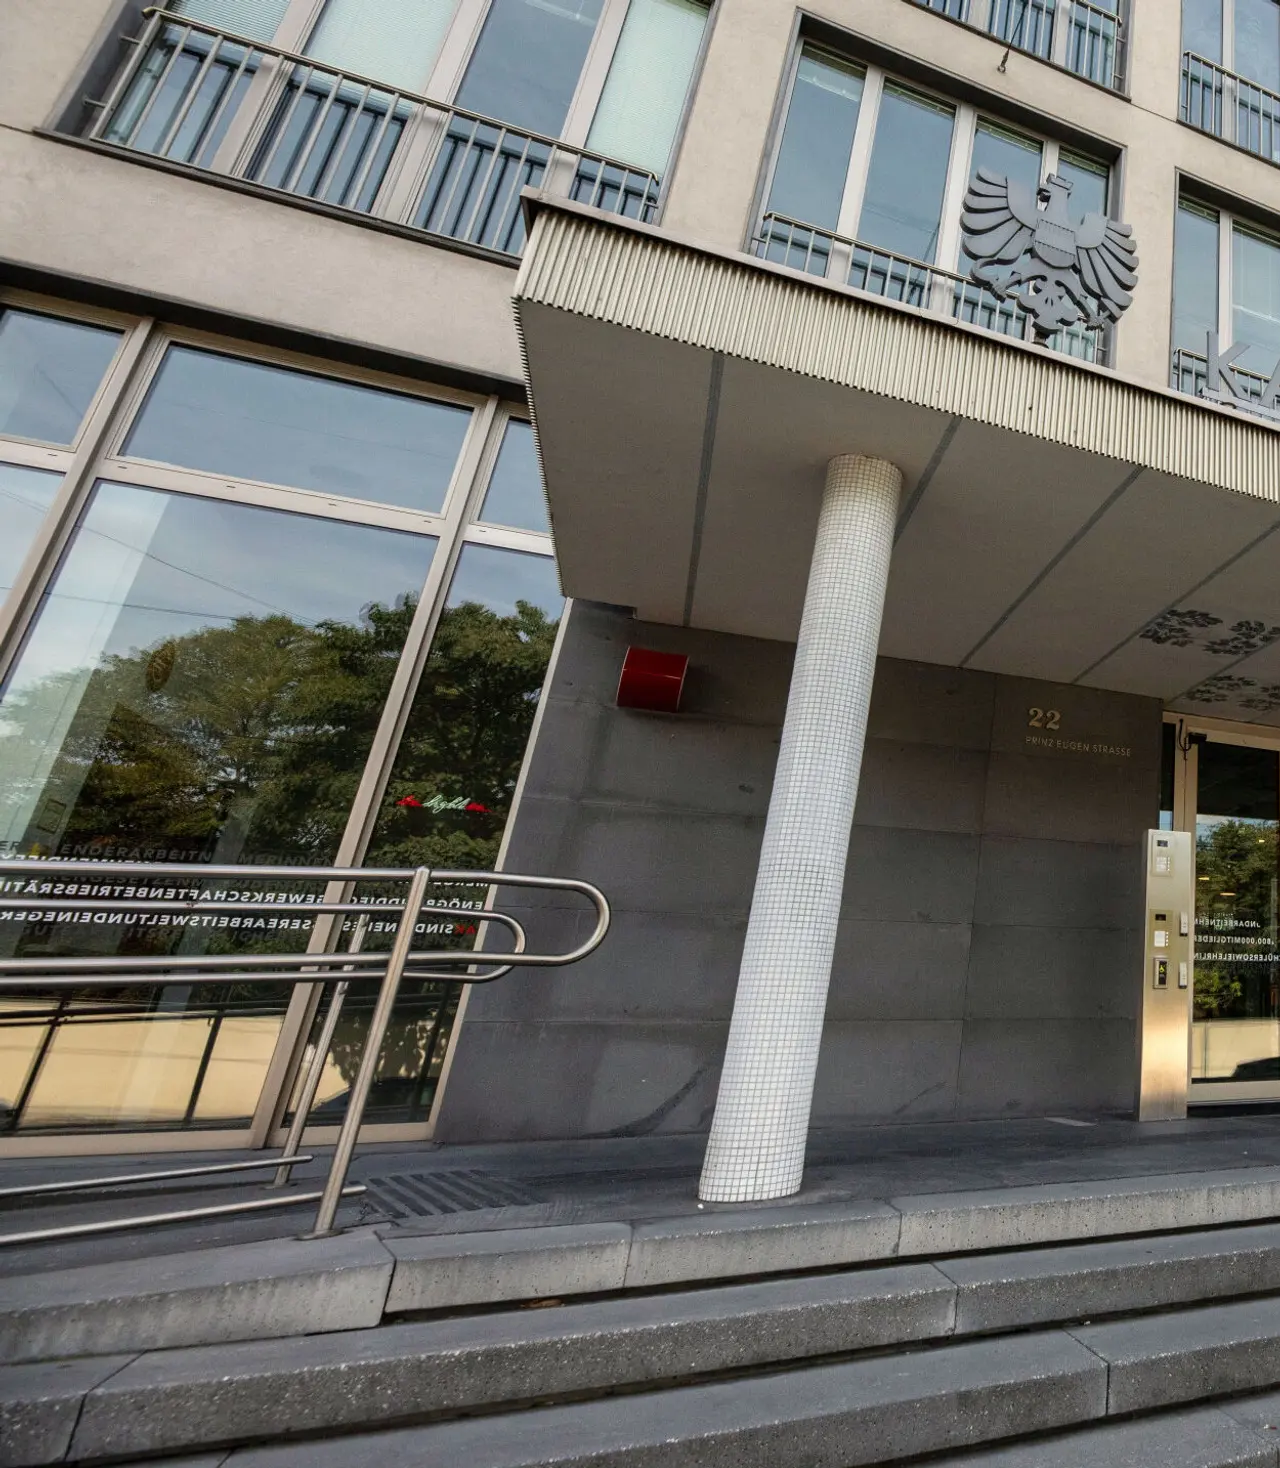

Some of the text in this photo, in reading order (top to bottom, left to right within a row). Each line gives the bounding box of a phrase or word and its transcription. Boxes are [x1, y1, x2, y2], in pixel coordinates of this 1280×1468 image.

[1029, 707, 1061, 730] 22
[1025, 736, 1131, 757] PRINZ EUGEN STRASSE
